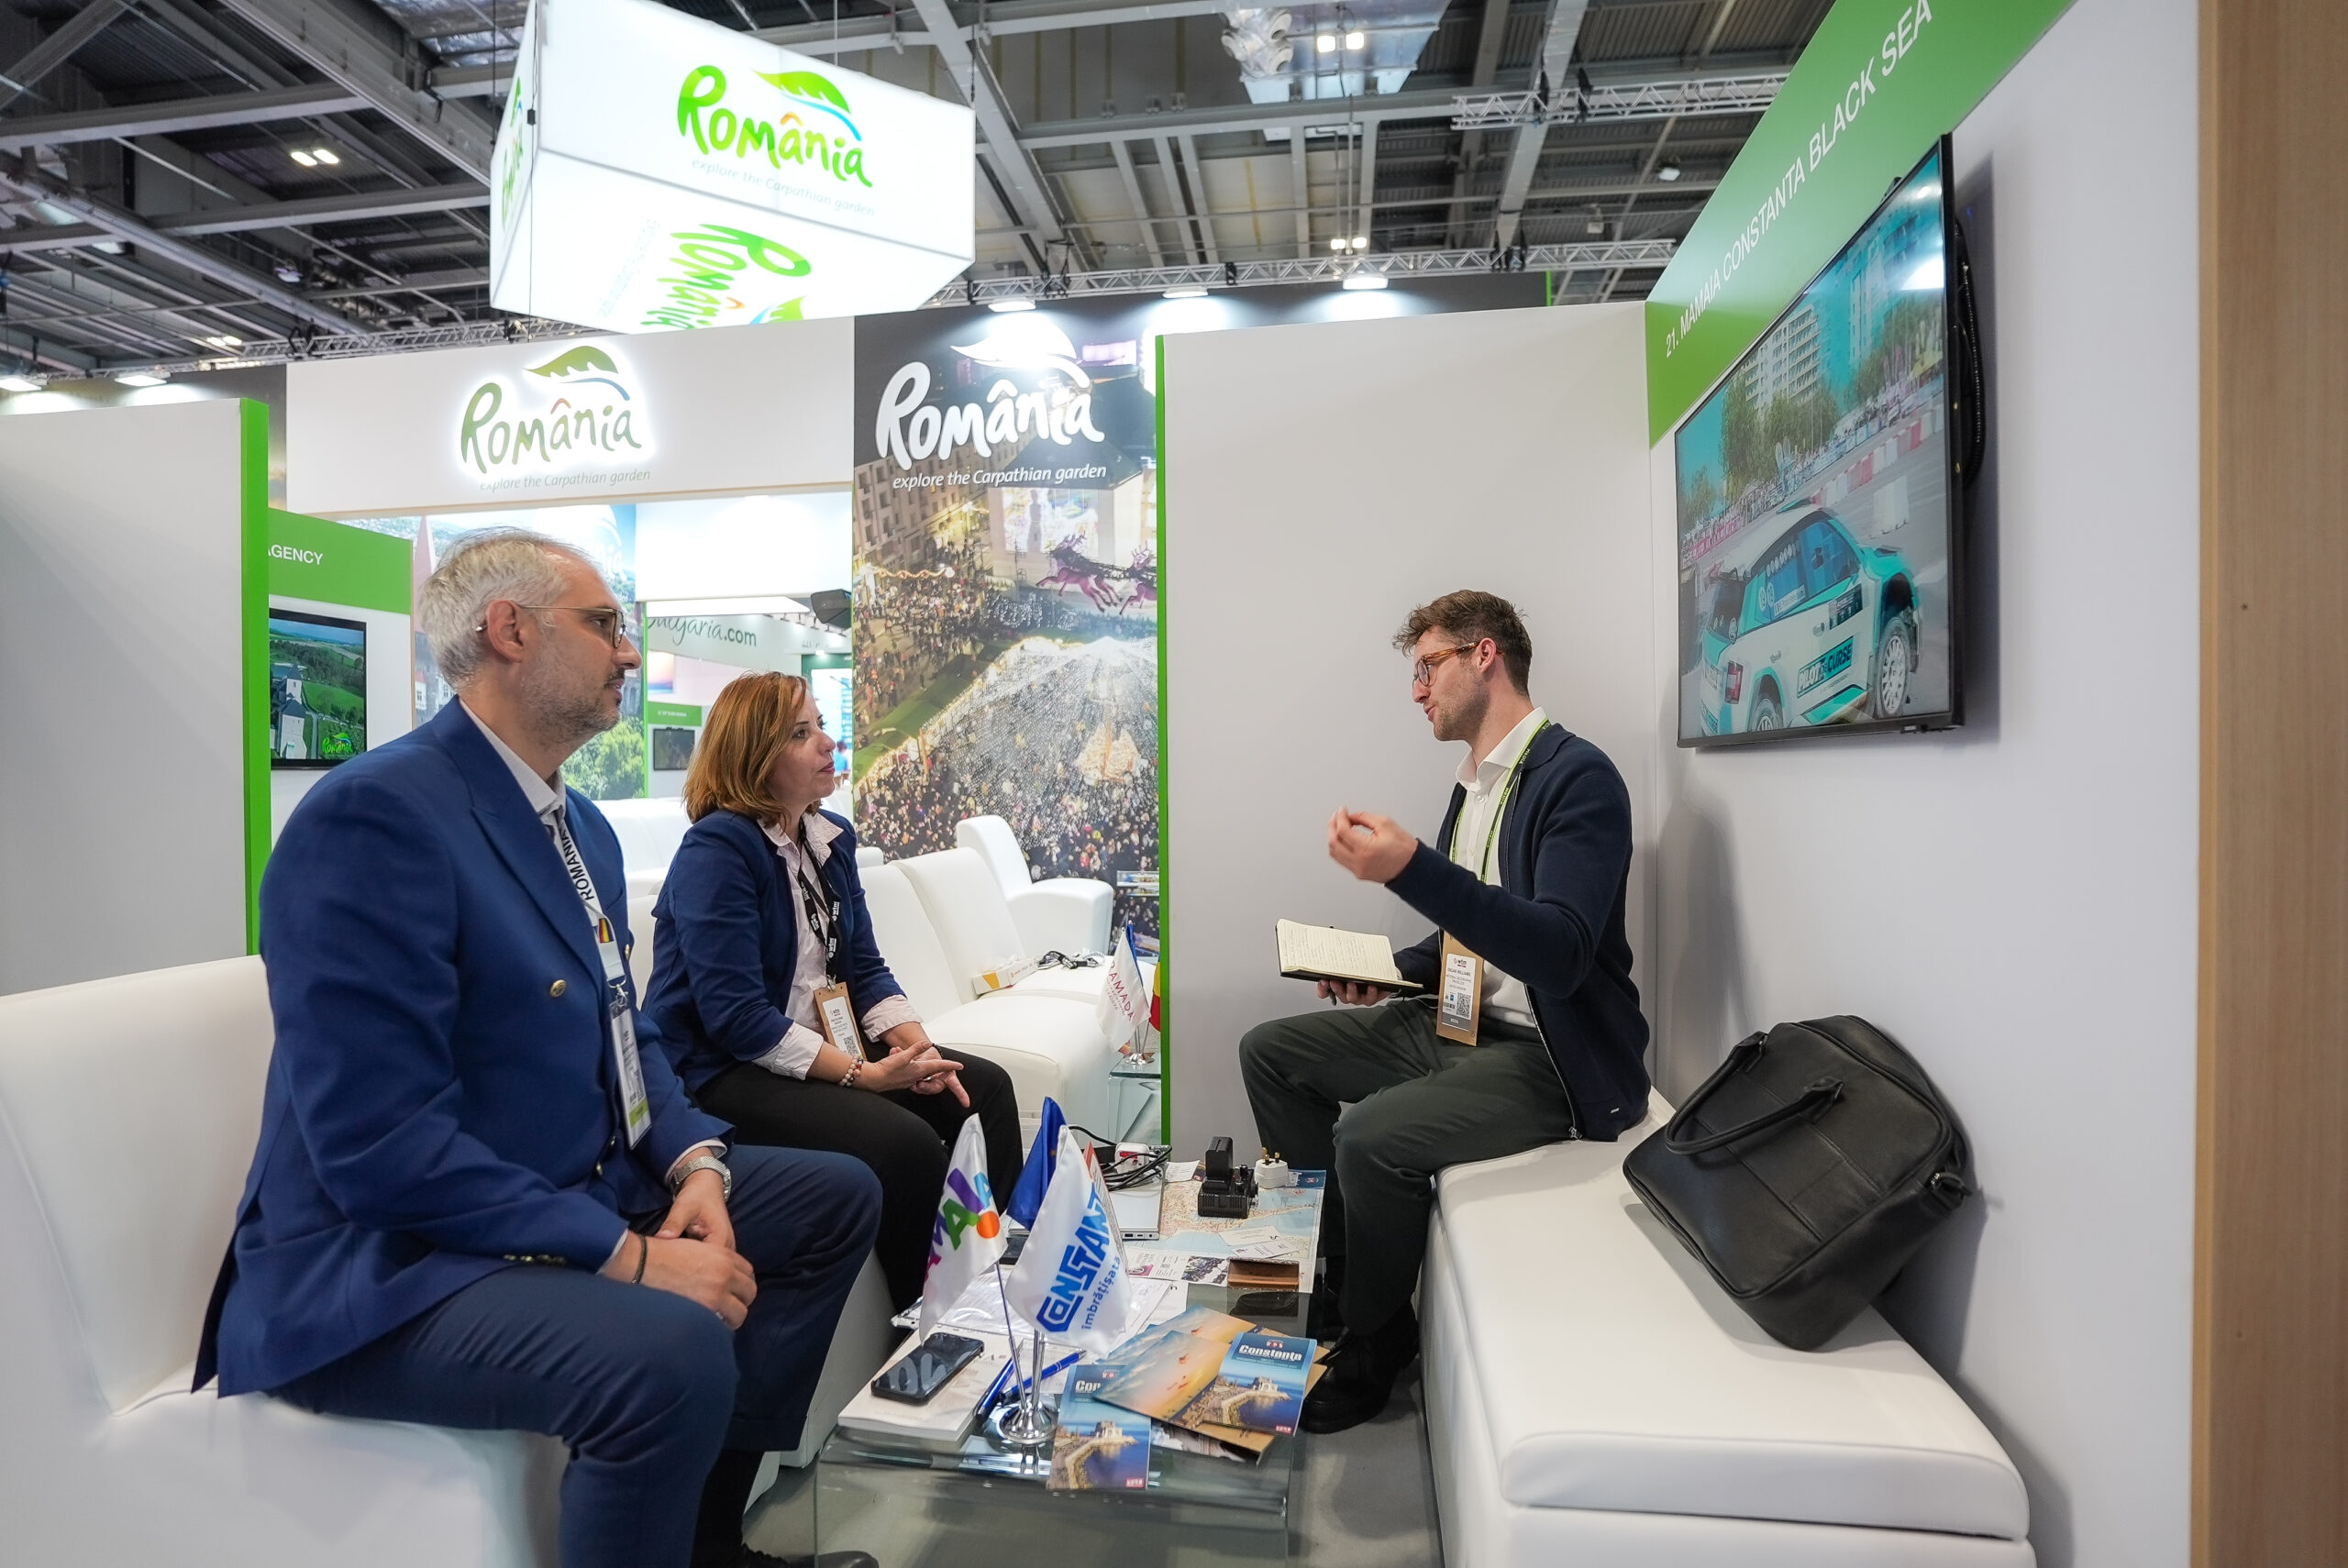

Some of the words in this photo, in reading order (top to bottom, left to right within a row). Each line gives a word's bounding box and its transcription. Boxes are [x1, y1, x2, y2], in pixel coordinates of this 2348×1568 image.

[678, 65, 872, 187] România
[692, 159, 739, 180] explore
[742, 171, 763, 185] the
[765, 178, 831, 204] Carpathian
[835, 199, 876, 217] garden
[1680, 269, 1721, 340] MAMAIA
[1722, 157, 1806, 282] CONSTANTA
[1809, 57, 1877, 172] BLACK
[1881, 0, 1933, 77] SEA
[460, 381, 641, 474] România
[875, 361, 1105, 471] România
[524, 475, 542, 488] the
[545, 472, 607, 490] Carpathian
[610, 469, 651, 486] garden
[892, 473, 944, 491] explore
[947, 470, 970, 485] the
[973, 468, 1051, 488] Carpathian
[1056, 465, 1107, 481] garden
[561, 828, 595, 901] ROMANIA
